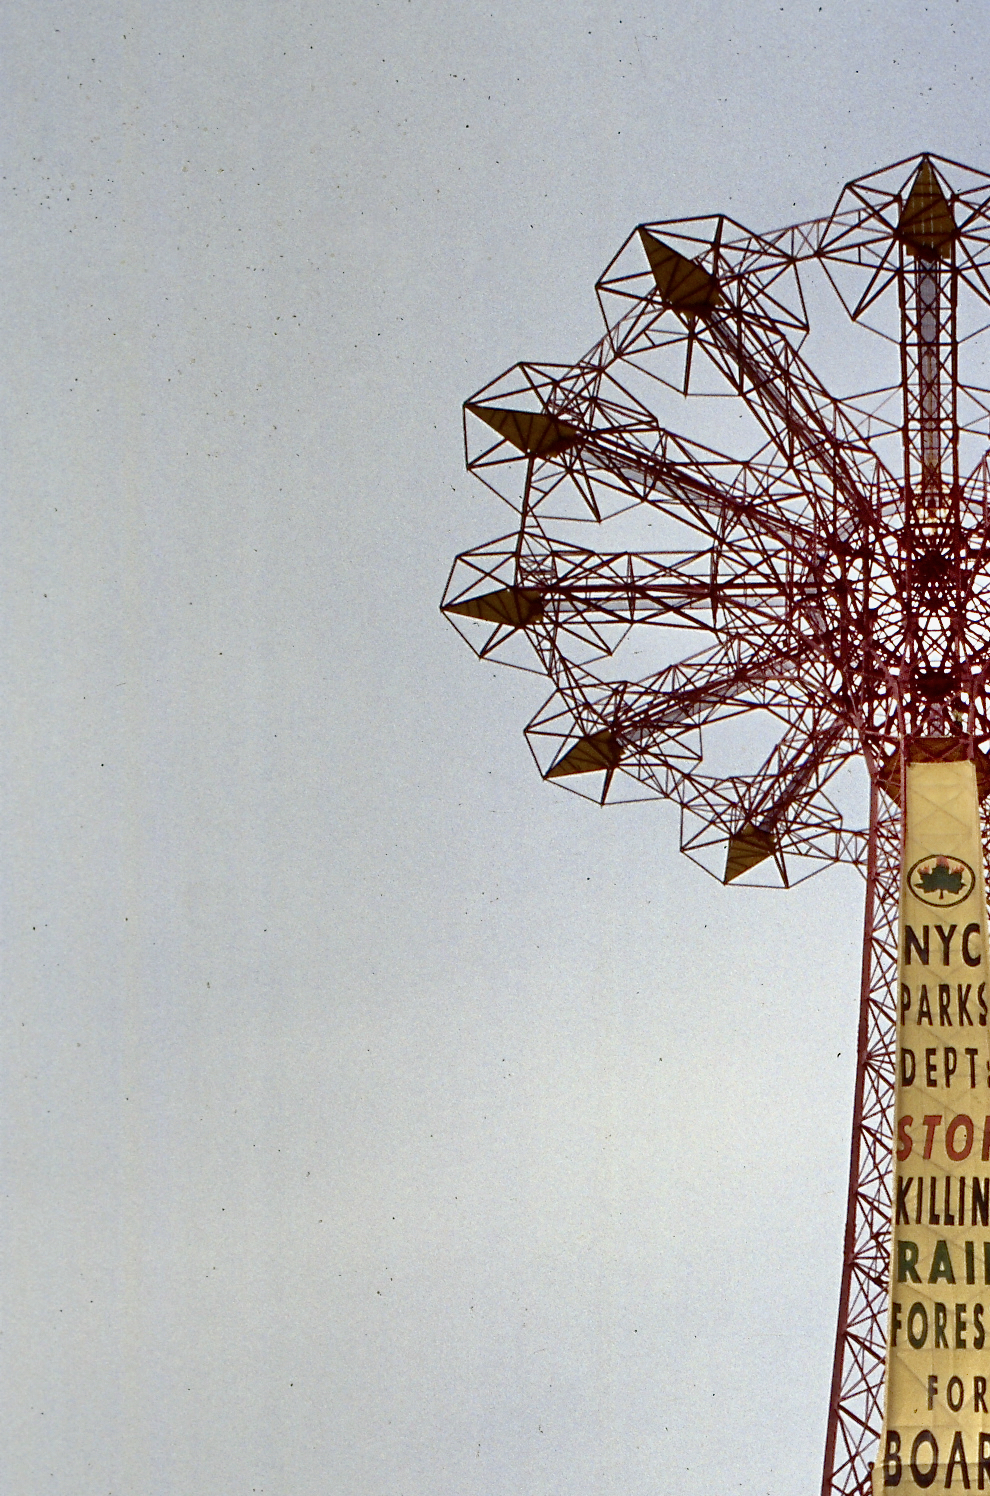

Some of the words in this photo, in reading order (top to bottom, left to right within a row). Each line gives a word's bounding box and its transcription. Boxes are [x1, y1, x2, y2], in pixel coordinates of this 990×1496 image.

[904, 922, 982, 967] NYC
[900, 982, 988, 1027] PARKS
[927, 1375, 988, 1413] FOR
